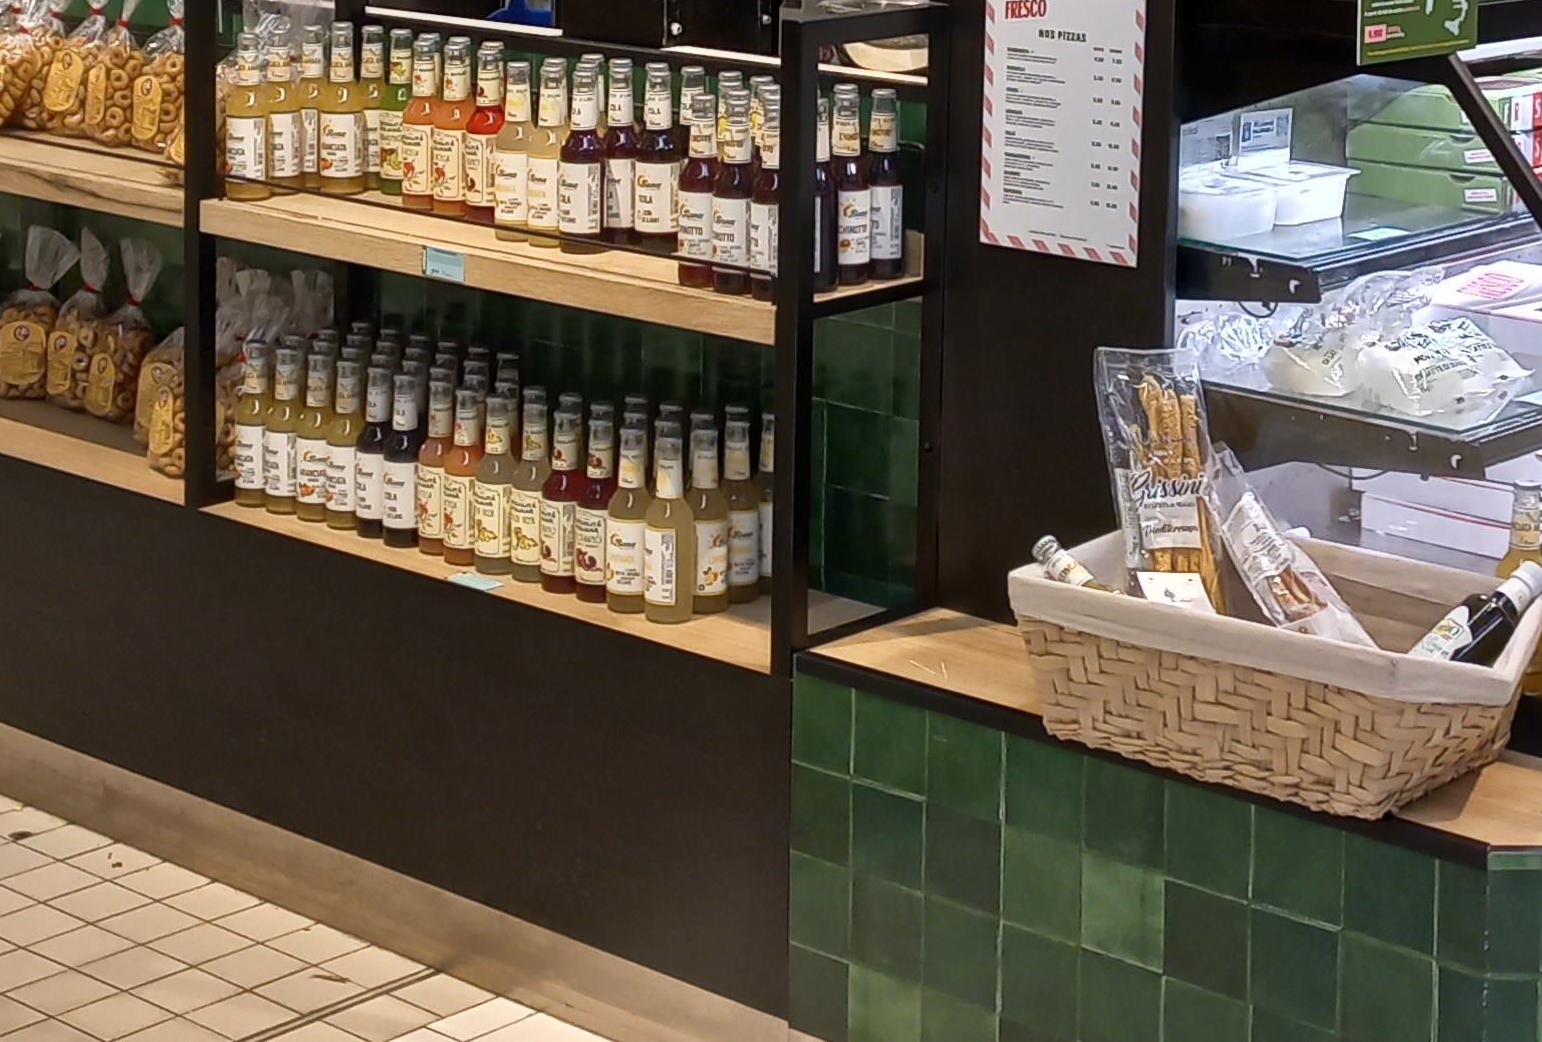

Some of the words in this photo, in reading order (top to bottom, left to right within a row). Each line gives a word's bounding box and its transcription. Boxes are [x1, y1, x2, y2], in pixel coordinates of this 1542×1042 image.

[1005, 0, 1047, 19] FRESCO
[1038, 28, 1055, 40] NOS
[1058, 31, 1087, 43] PIZZAS
[1130, 469, 1204, 503] Grissini
